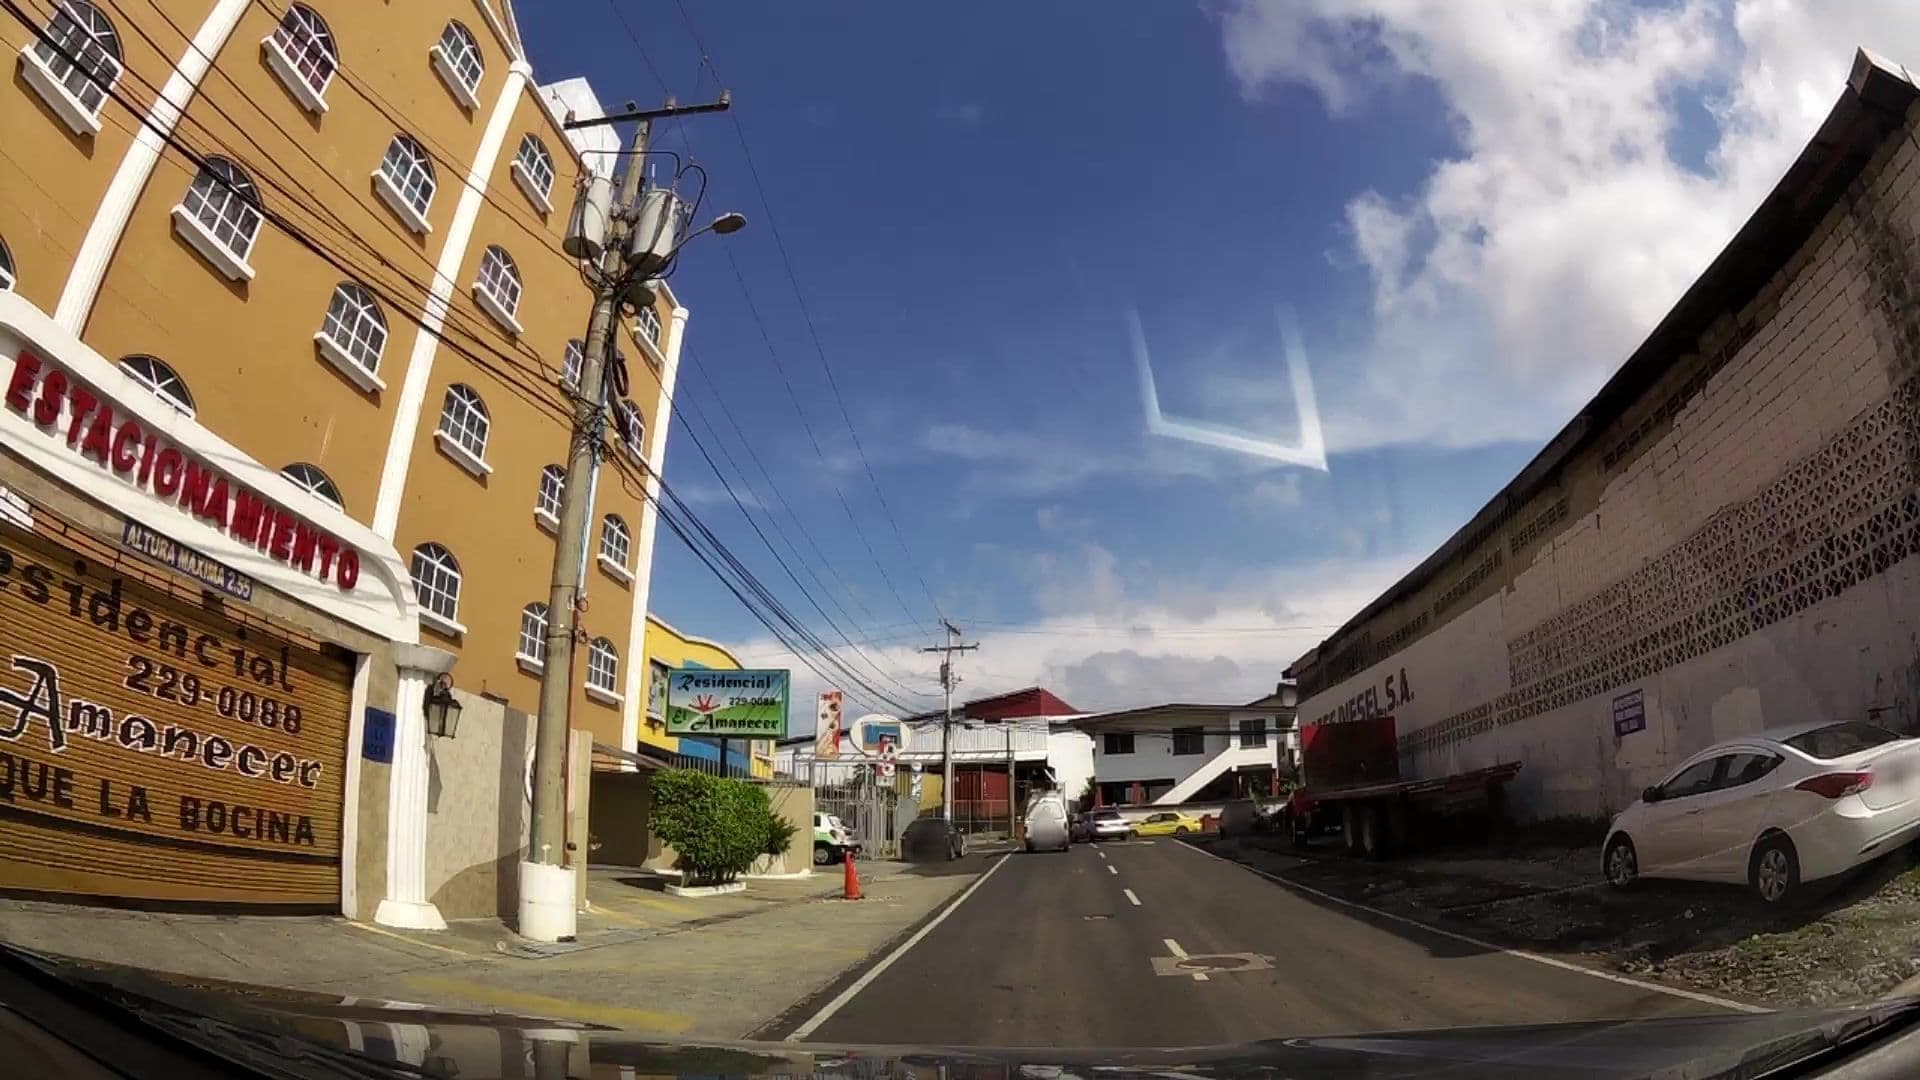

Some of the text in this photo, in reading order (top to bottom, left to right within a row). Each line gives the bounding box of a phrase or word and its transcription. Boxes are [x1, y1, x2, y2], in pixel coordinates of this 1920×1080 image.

[6, 350, 360, 589] ESTACIONAMIENTO
[126, 524, 251, 599] ALTURA MAXIMA 2.55
[123, 655, 302, 735] 229-0088
[672, 709, 779, 731] El Amanecer
[677, 673, 771, 692] Residencial
[0, 654, 323, 790] Amanecer
[100, 778, 151, 823] LA
[180, 795, 315, 845] BOCINA
